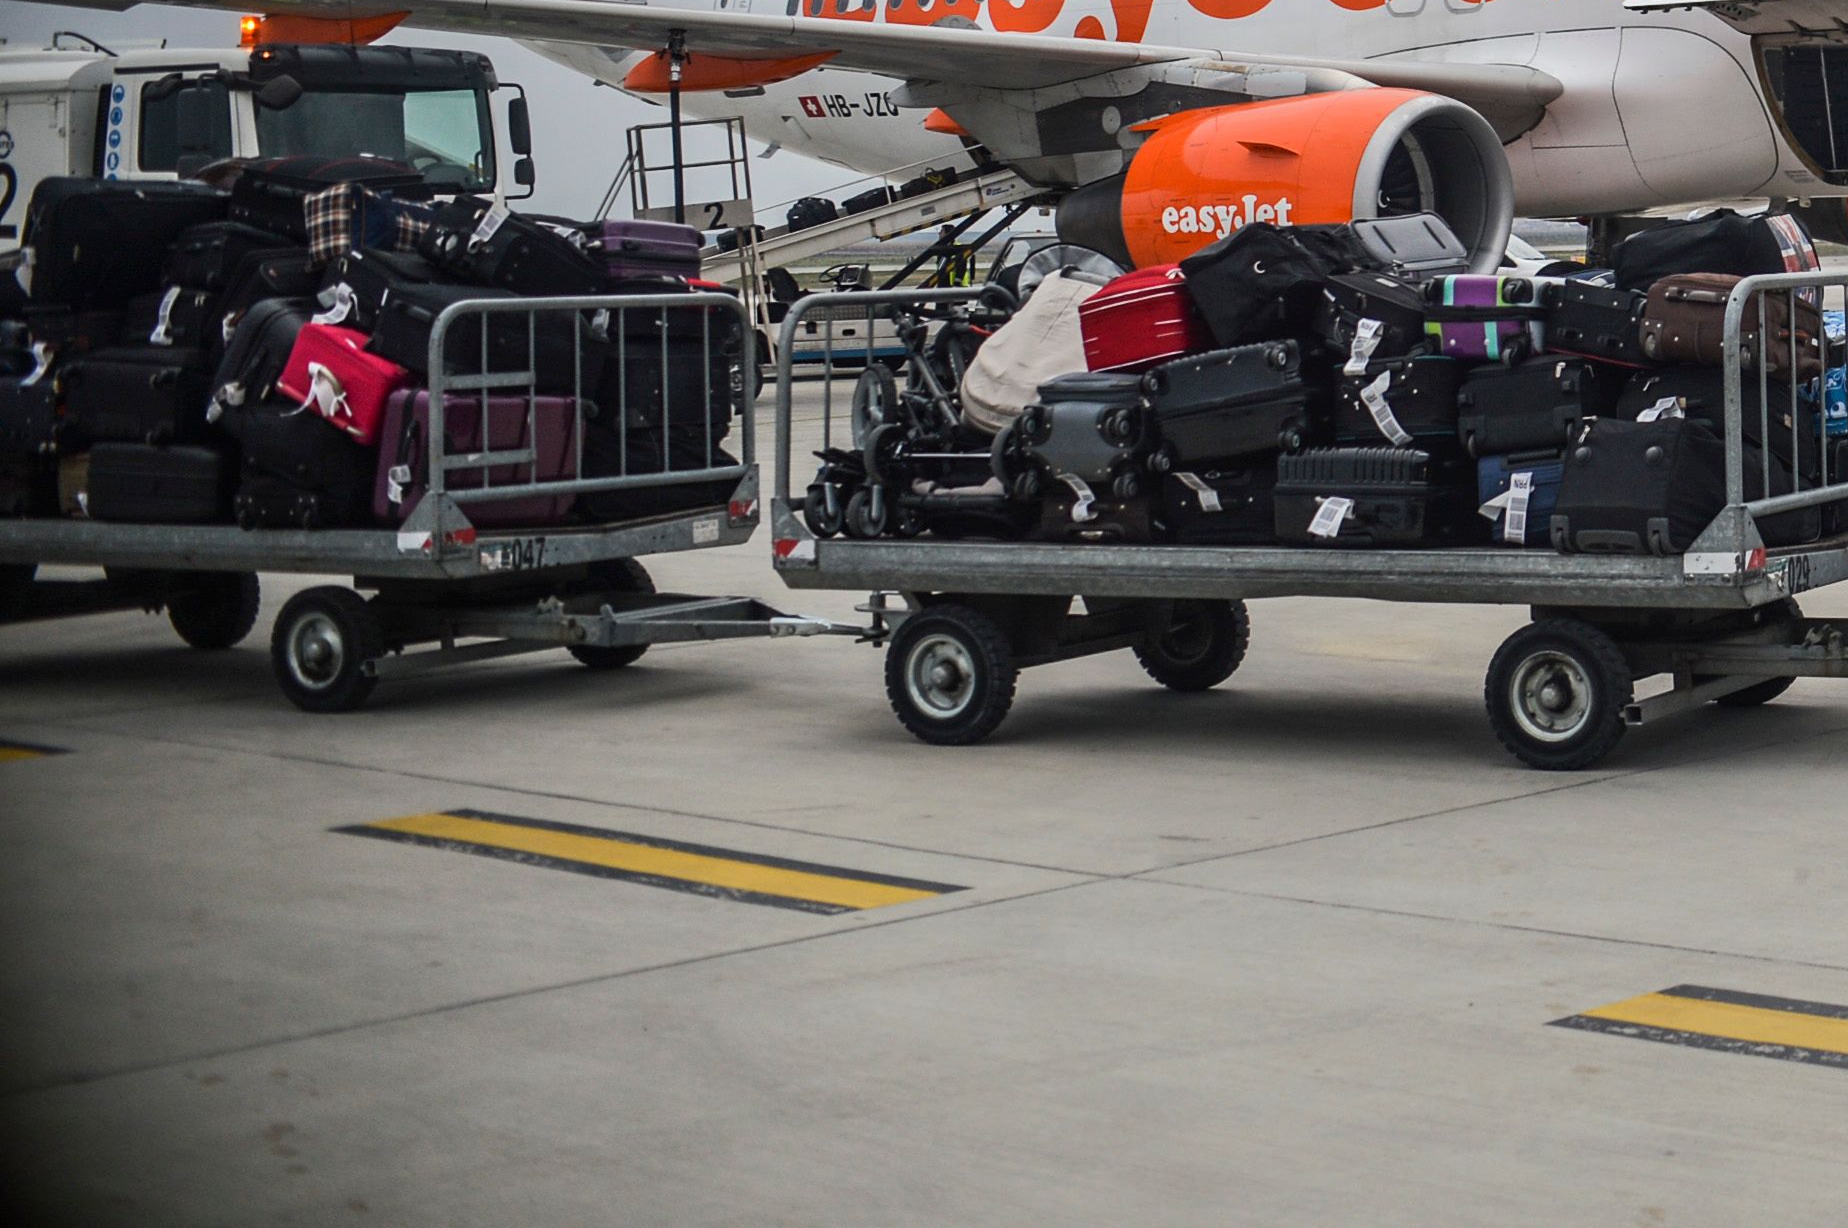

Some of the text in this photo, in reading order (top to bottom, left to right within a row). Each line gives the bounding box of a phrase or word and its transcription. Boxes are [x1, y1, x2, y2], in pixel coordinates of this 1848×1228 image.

[704, 202, 728, 230] 2
[1161, 194, 1293, 240] easyJet
[511, 537, 546, 569] 047
[1787, 554, 1810, 594] 029
